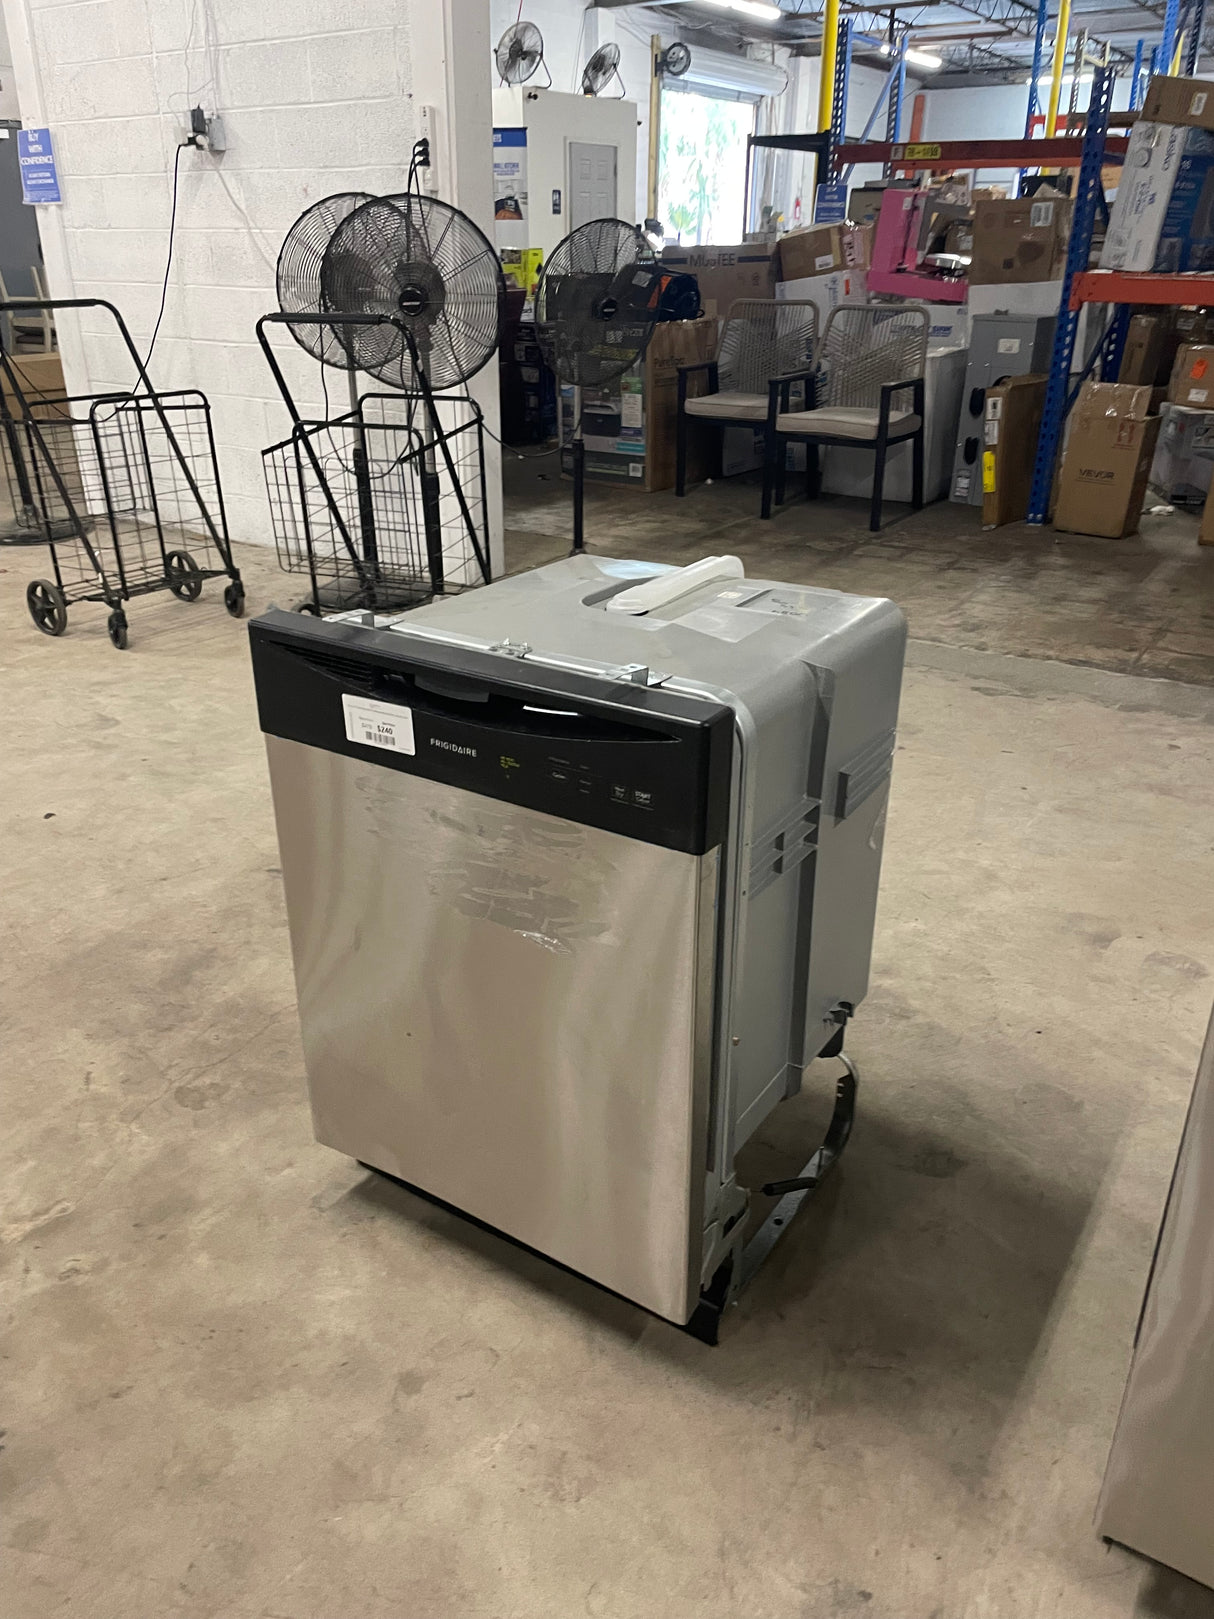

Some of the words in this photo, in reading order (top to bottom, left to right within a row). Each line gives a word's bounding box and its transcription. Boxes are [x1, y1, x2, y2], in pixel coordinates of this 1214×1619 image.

[1079, 468, 1115, 479] VEVOR
[377, 725, 393, 735] $240
[430, 738, 477, 757] FRIGIDAIRE
